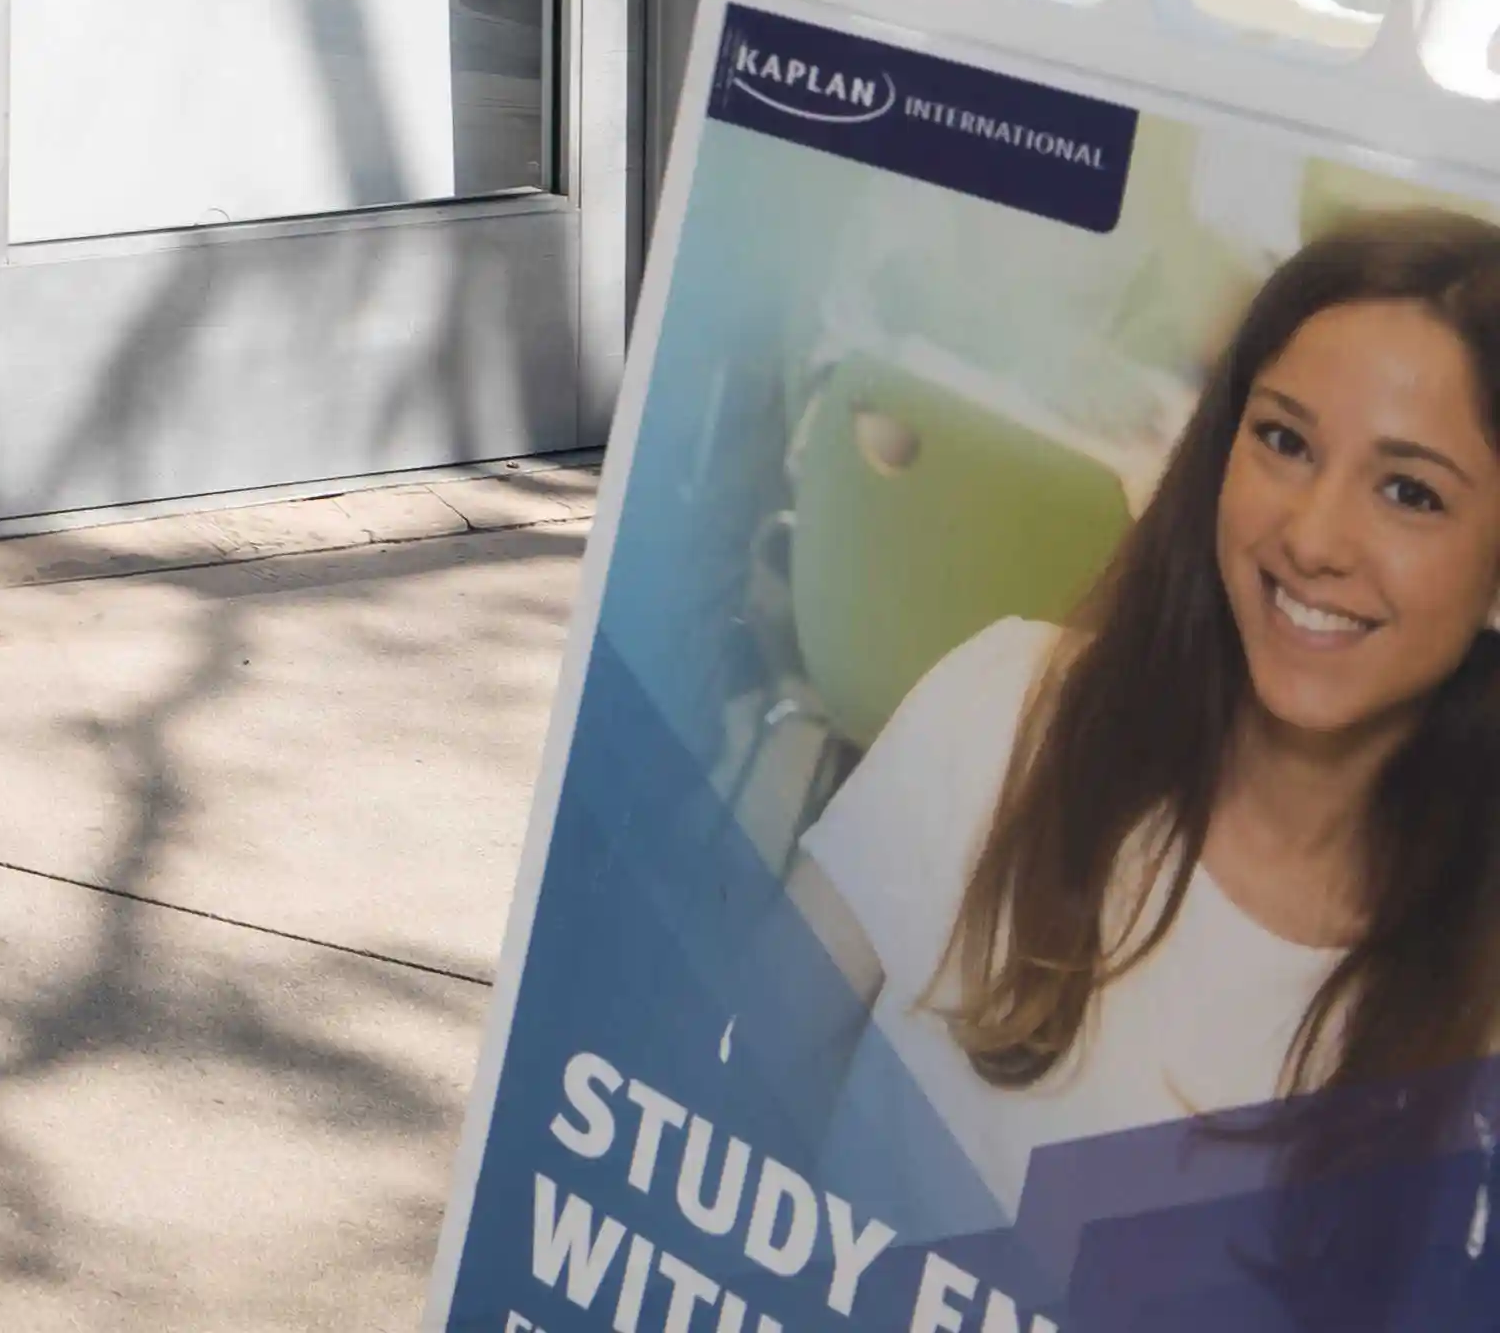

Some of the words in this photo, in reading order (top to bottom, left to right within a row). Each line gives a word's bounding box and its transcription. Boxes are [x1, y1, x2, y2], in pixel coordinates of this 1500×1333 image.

[734, 43, 877, 109] KAPLAN
[904, 95, 1106, 171] INTERNATIONAL
[549, 1051, 897, 1317] STUDY
